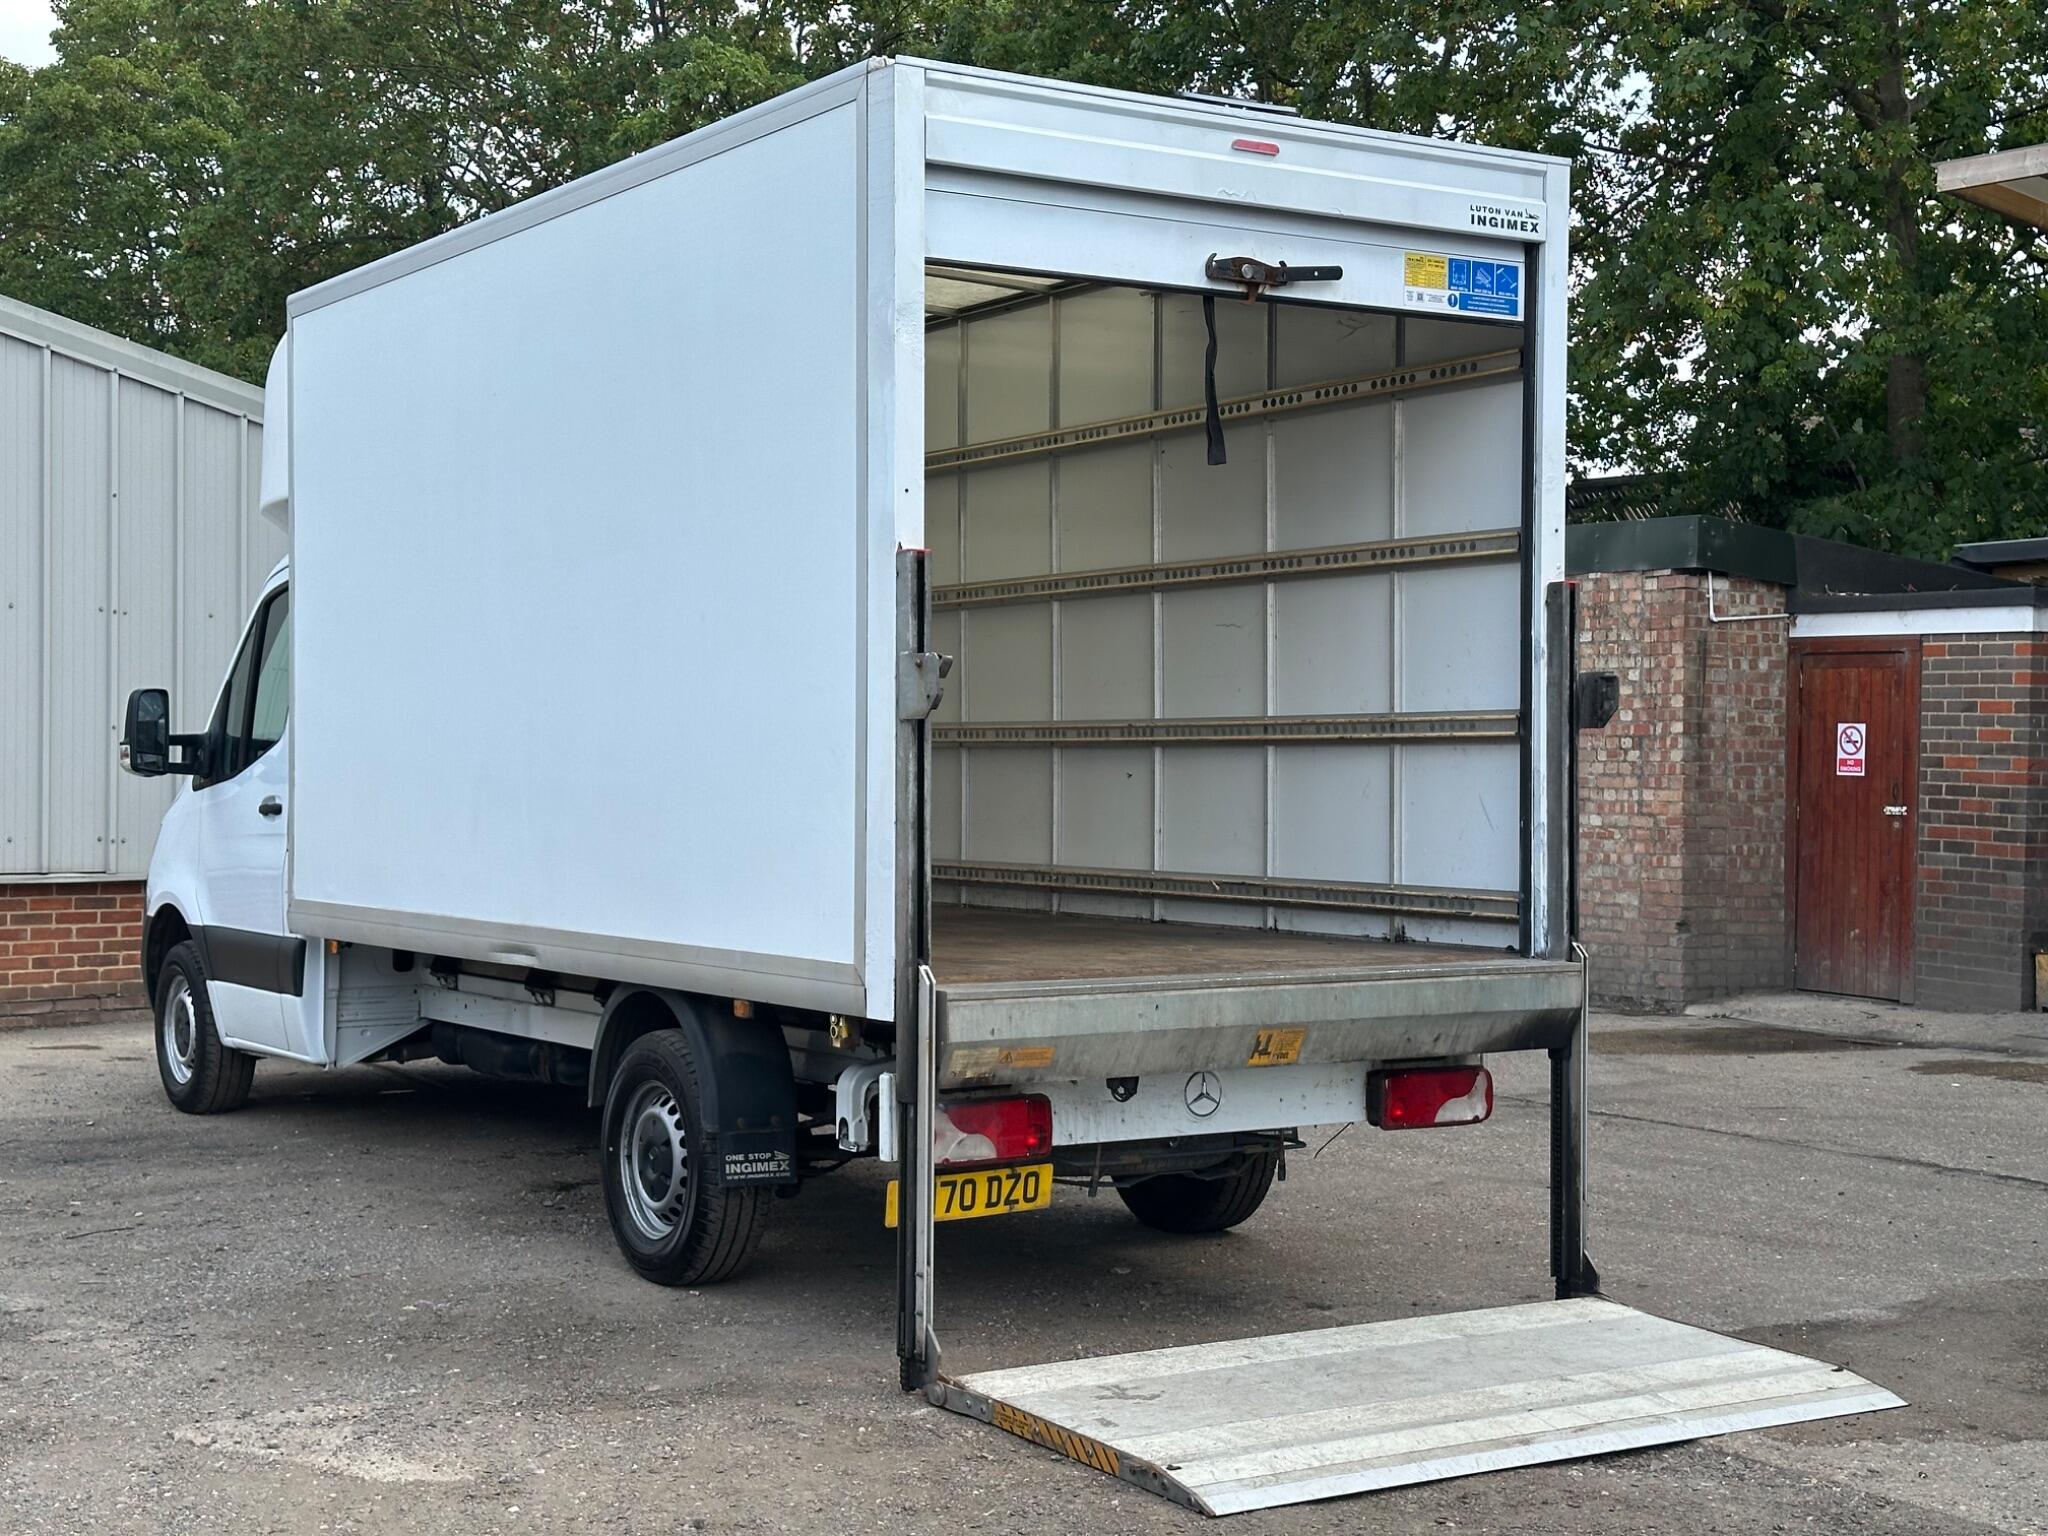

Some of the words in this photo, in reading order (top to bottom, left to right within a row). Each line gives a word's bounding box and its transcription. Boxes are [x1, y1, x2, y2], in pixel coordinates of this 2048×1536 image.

[1470, 204, 1501, 215] LUTON
[1505, 209, 1523, 218] VAN
[1470, 213, 1539, 233] INGIMEX
[748, 1152, 771, 1160] STOP
[725, 1160, 790, 1174] INGIMEX
[934, 1177, 977, 1214] 70
[985, 1170, 1040, 1209] DZO
